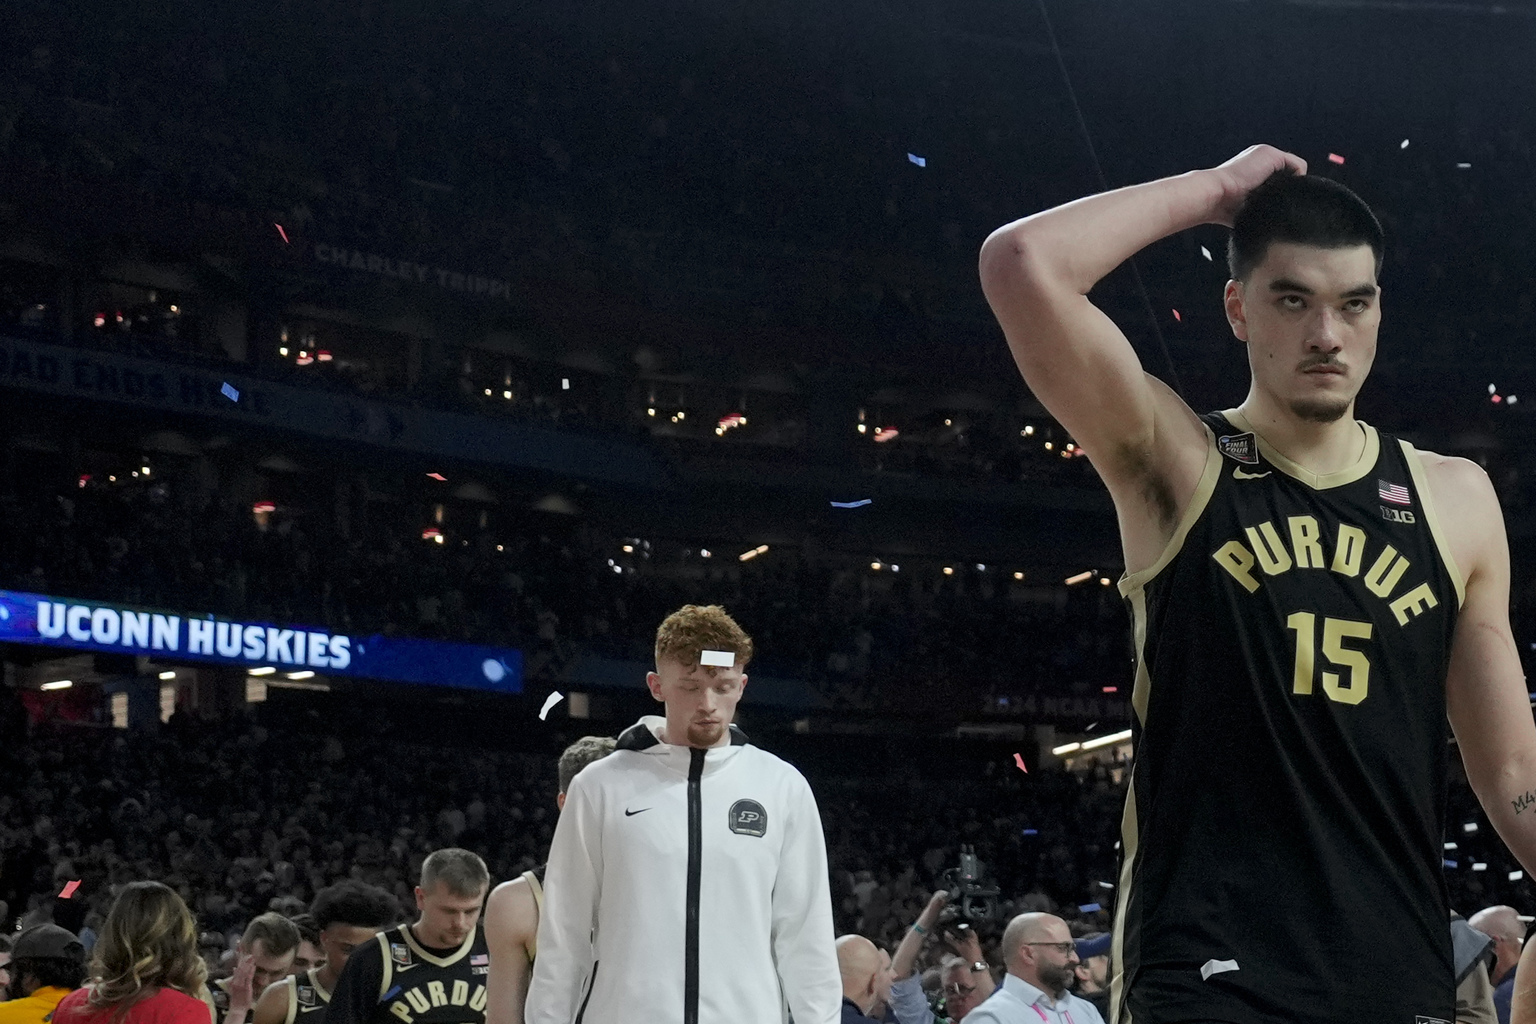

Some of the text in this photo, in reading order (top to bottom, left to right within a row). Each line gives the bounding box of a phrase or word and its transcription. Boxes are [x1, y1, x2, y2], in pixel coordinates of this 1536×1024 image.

[314, 242, 511, 300] CHARLEY TRIPPI
[73, 359, 167, 398] ENDS
[1225, 440, 1248, 448] FINAL
[1212, 514, 1439, 627] PURDUE
[36, 600, 351, 669] UCONN HUSKIES
[1287, 611, 1373, 705] 15
[390, 979, 487, 1024] PURDU
